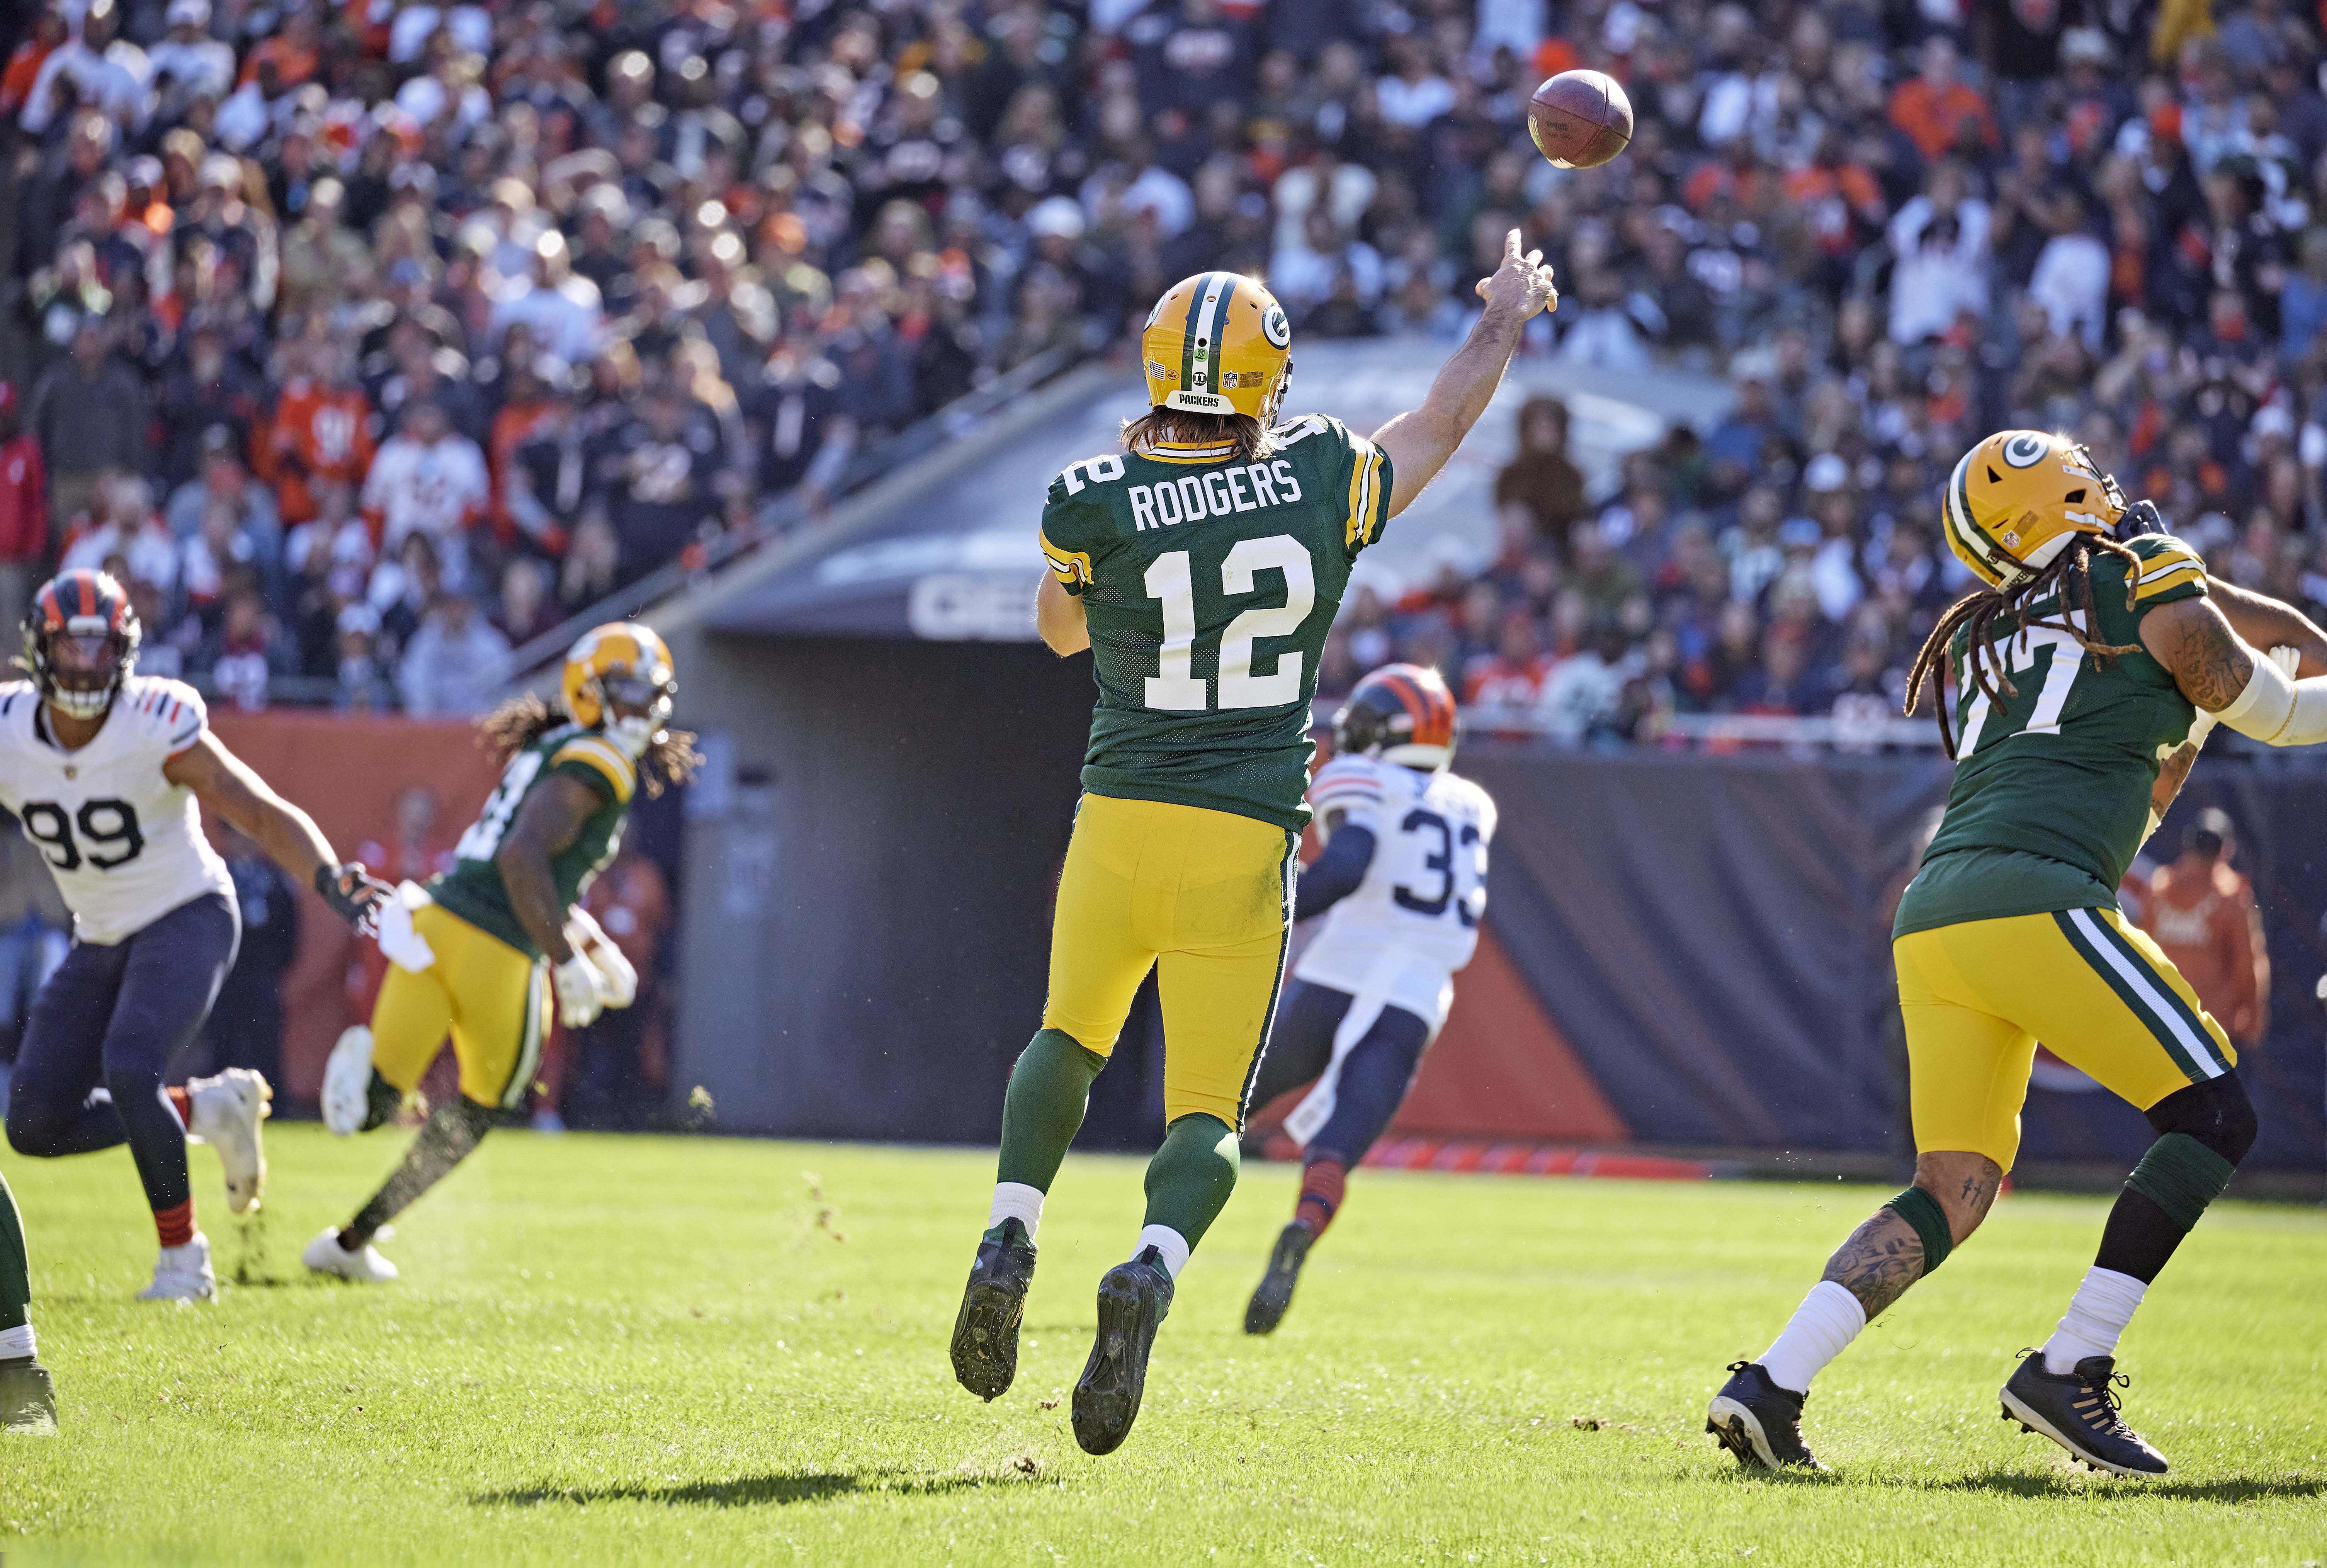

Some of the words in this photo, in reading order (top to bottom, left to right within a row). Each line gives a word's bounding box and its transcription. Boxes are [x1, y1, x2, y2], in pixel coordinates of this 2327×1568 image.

[1179, 394, 1219, 407] PACKERS
[1128, 460, 1302, 532] RODGERS
[1144, 533, 1315, 710] 12
[21, 798, 145, 871] 99
